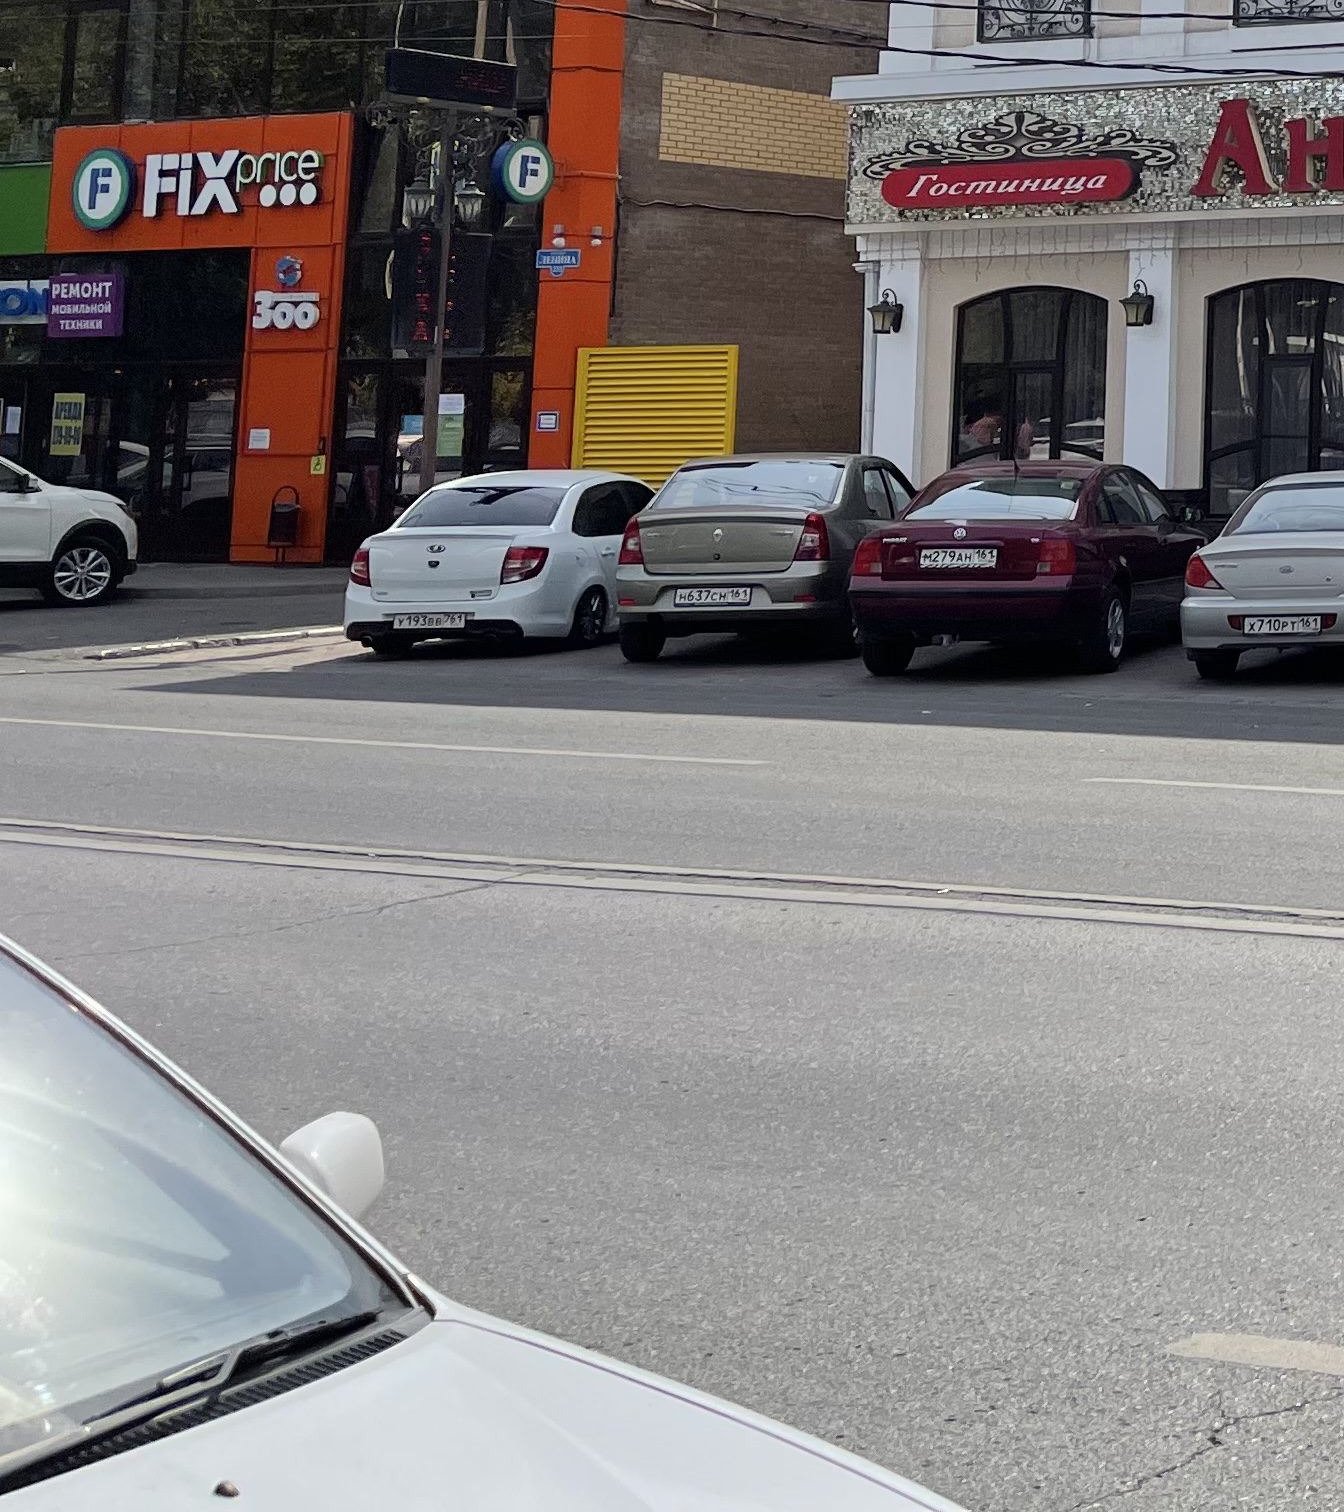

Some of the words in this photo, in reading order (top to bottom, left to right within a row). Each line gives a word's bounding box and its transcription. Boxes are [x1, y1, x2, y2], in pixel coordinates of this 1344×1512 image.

[235, 149, 322, 193] price
[906, 173, 1109, 197] Гостиница
[52, 282, 113, 299] РЕМОНТ
[51, 300, 112, 315] МОБИЛЬНОЙ
[59, 319, 103, 330] ТЕХНИКИ
[1248, 618, 1296, 631] Х710РТ
[1299, 617, 1318, 628] 161
